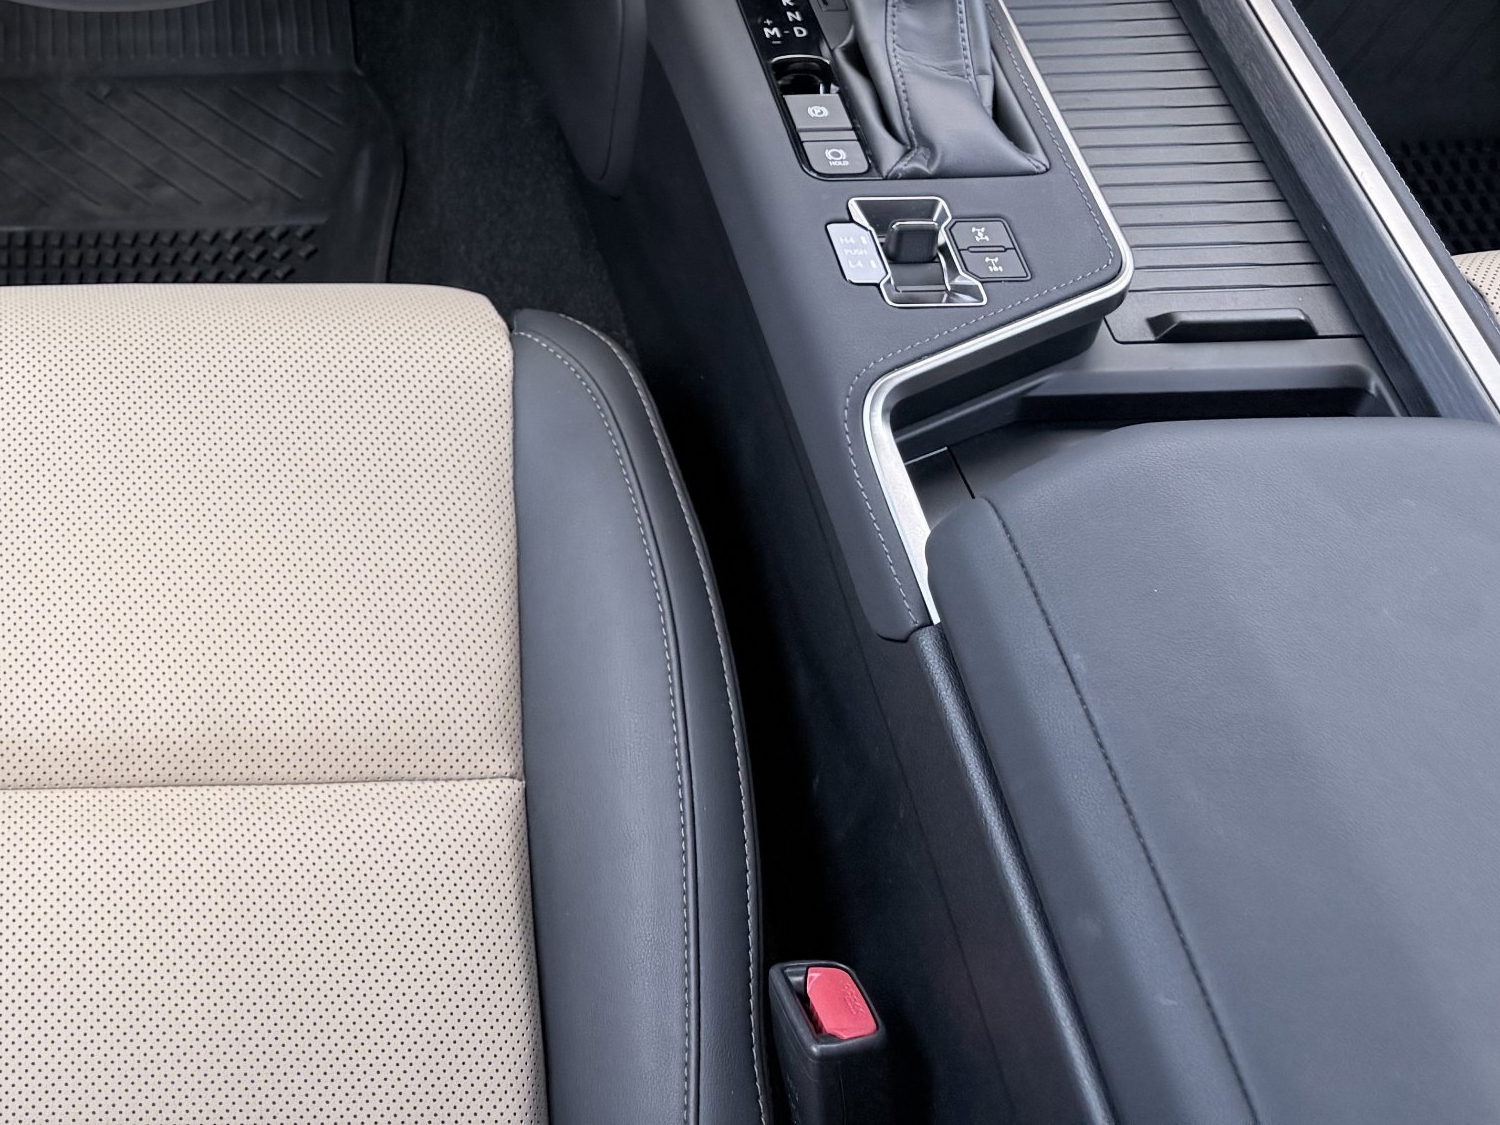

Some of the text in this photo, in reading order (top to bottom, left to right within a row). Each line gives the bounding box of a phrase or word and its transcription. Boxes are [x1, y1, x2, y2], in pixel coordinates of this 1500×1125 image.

[786, 10, 802, 22] N
[763, 26, 781, 39] M
[792, 26, 808, 38] D
